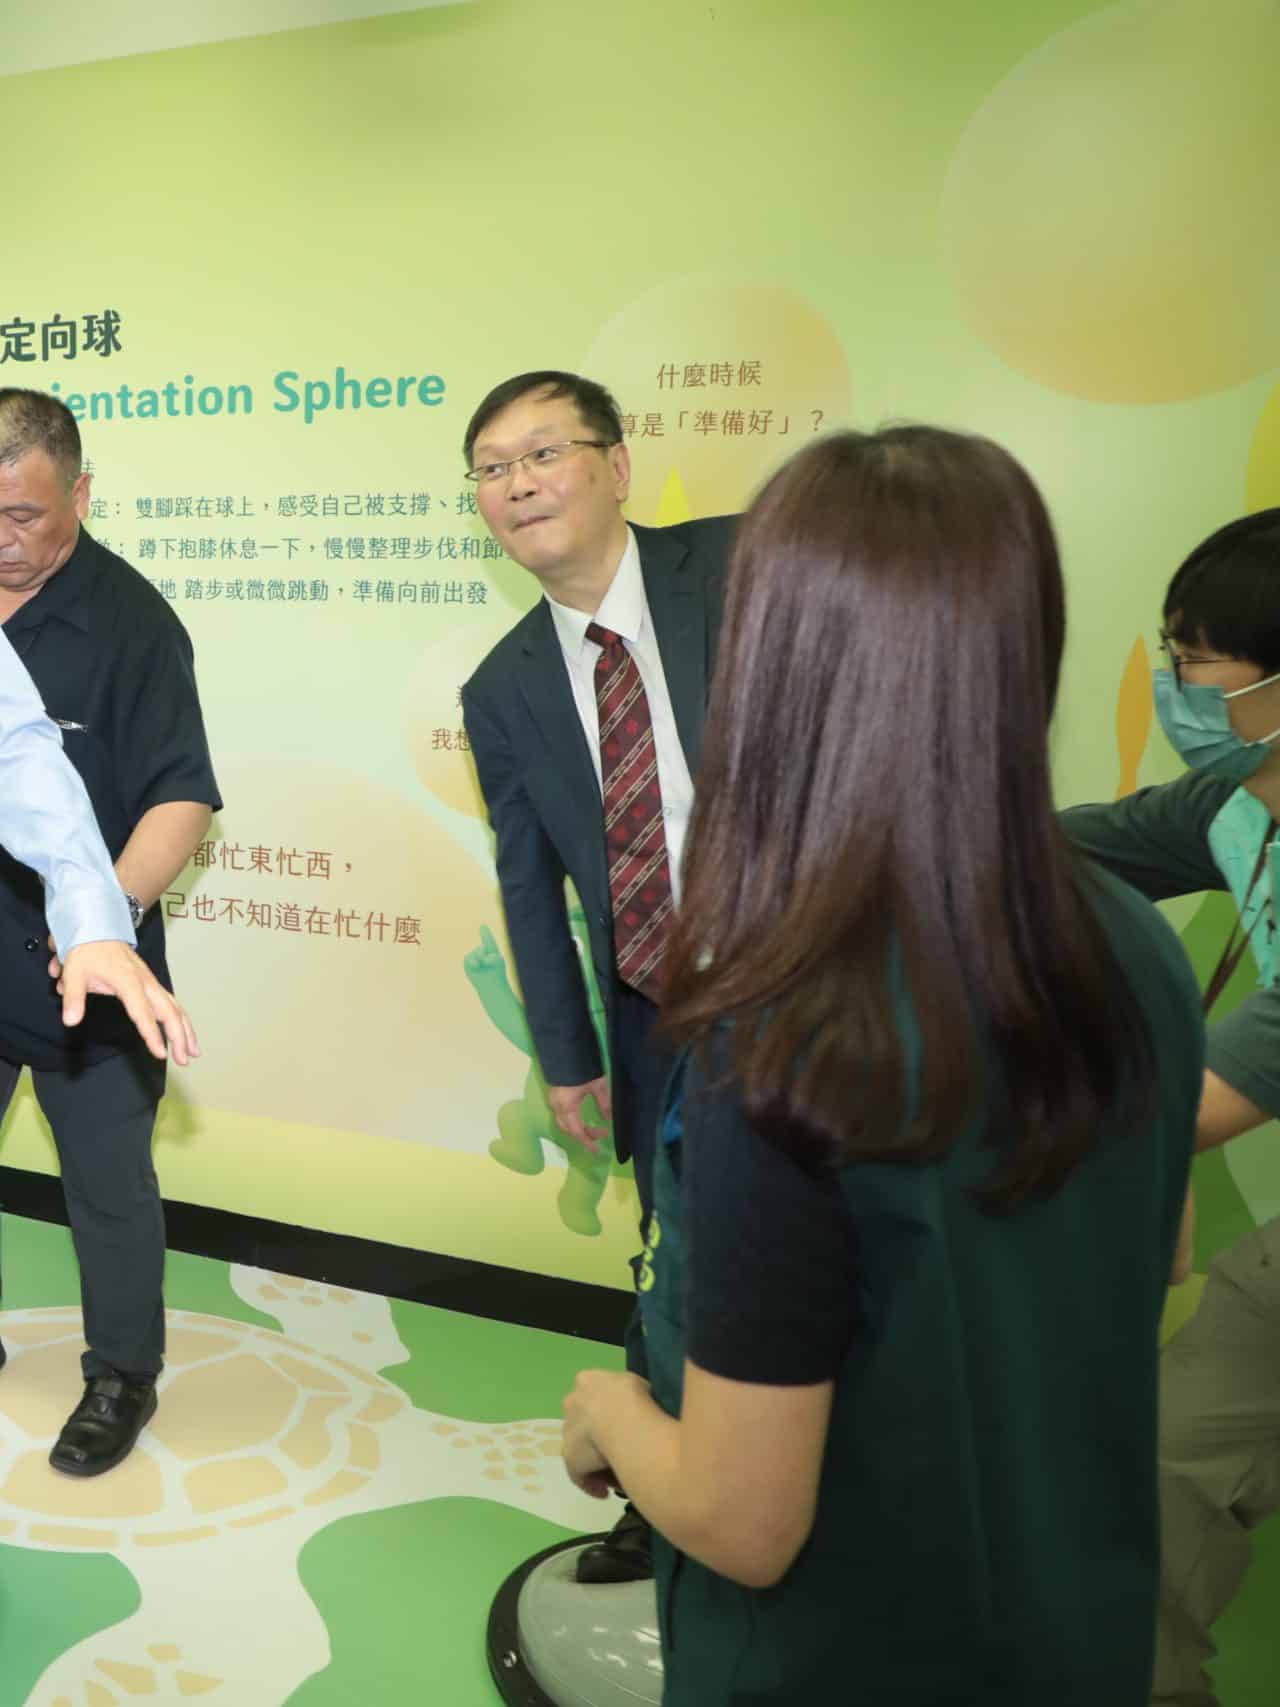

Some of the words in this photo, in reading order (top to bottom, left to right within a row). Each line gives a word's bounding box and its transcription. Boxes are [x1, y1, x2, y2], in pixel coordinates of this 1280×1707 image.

[0, 309, 122, 364] 定向球
[273, 367, 446, 424] Sphere
[656, 360, 761, 389] 什麼時候
[138, 535, 512, 561] 蹲下抱膝休息一下，慢慢整理步伐和節
[166, 891, 421, 945] 己也不知道在忙什麼
